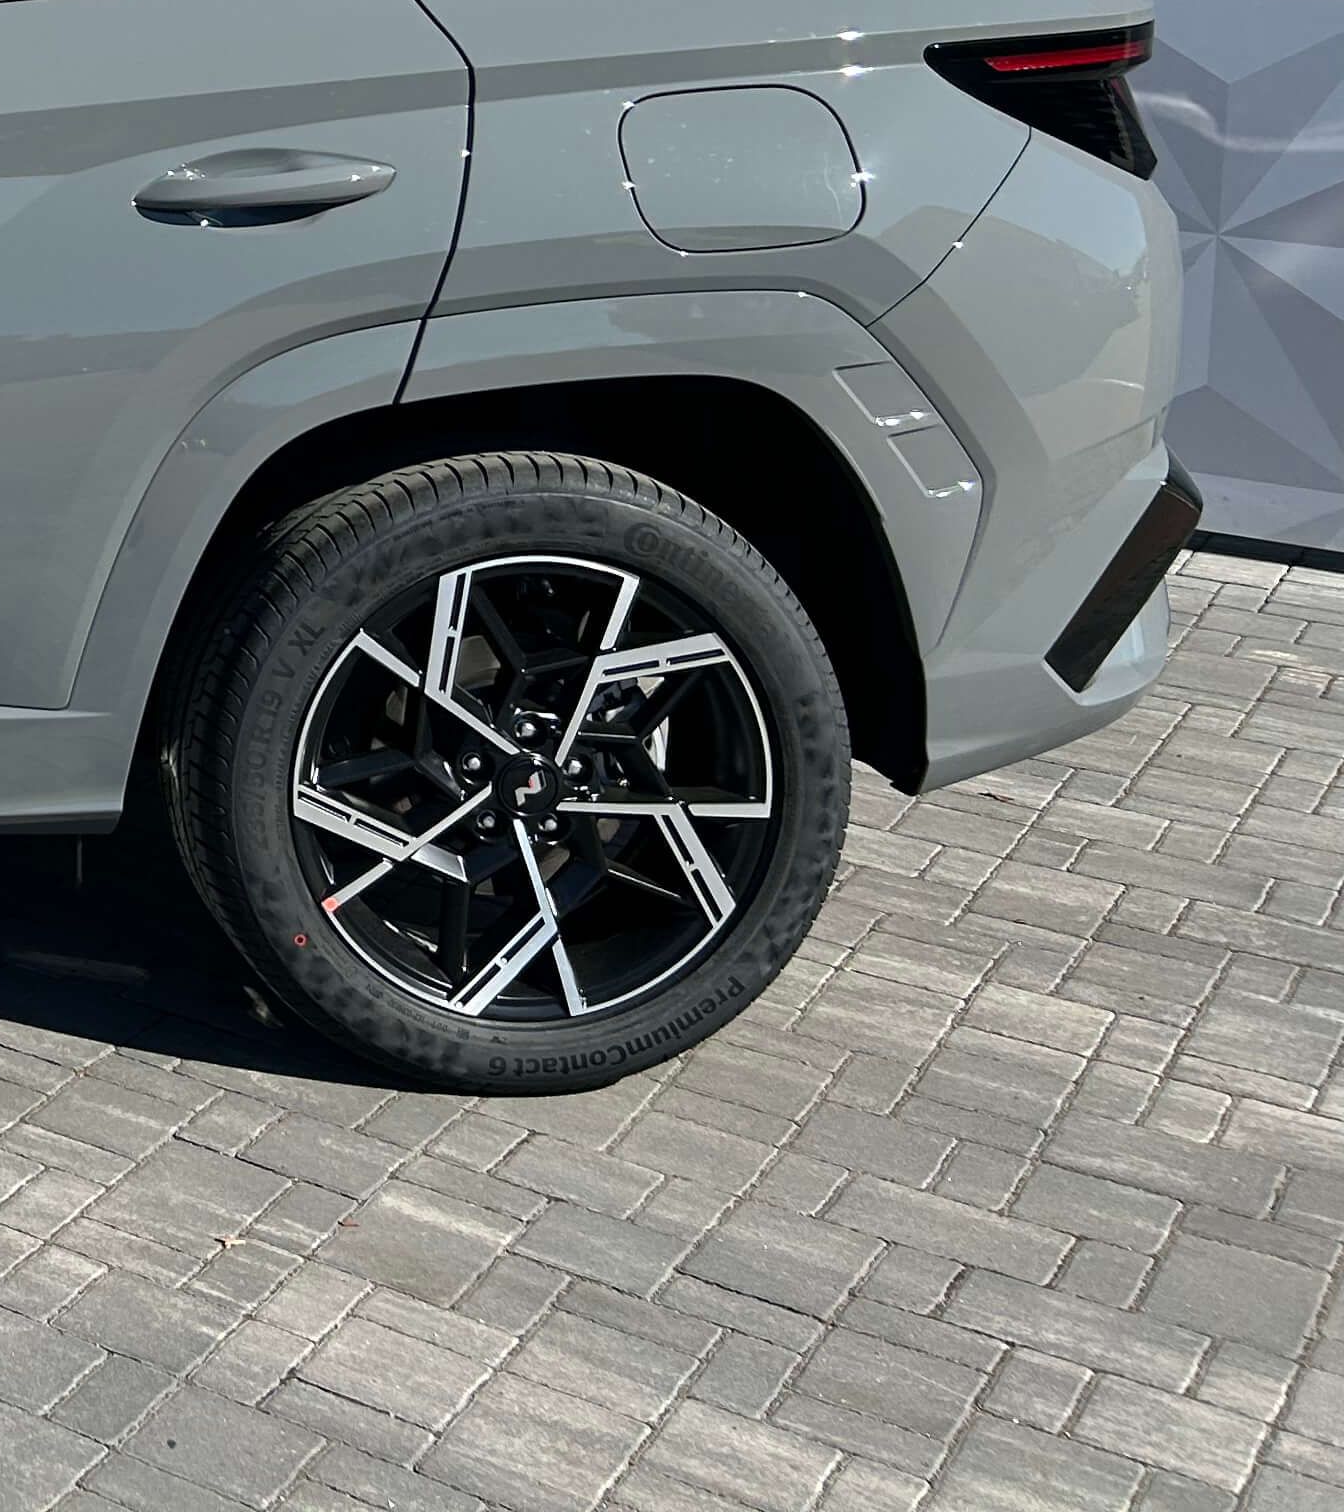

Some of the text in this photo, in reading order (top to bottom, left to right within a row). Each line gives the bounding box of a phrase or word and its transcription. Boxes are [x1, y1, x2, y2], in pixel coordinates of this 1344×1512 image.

[624, 522, 792, 654] Continea
[488, 1055, 507, 1077] 6
[513, 976, 745, 1077] PremiumContact
